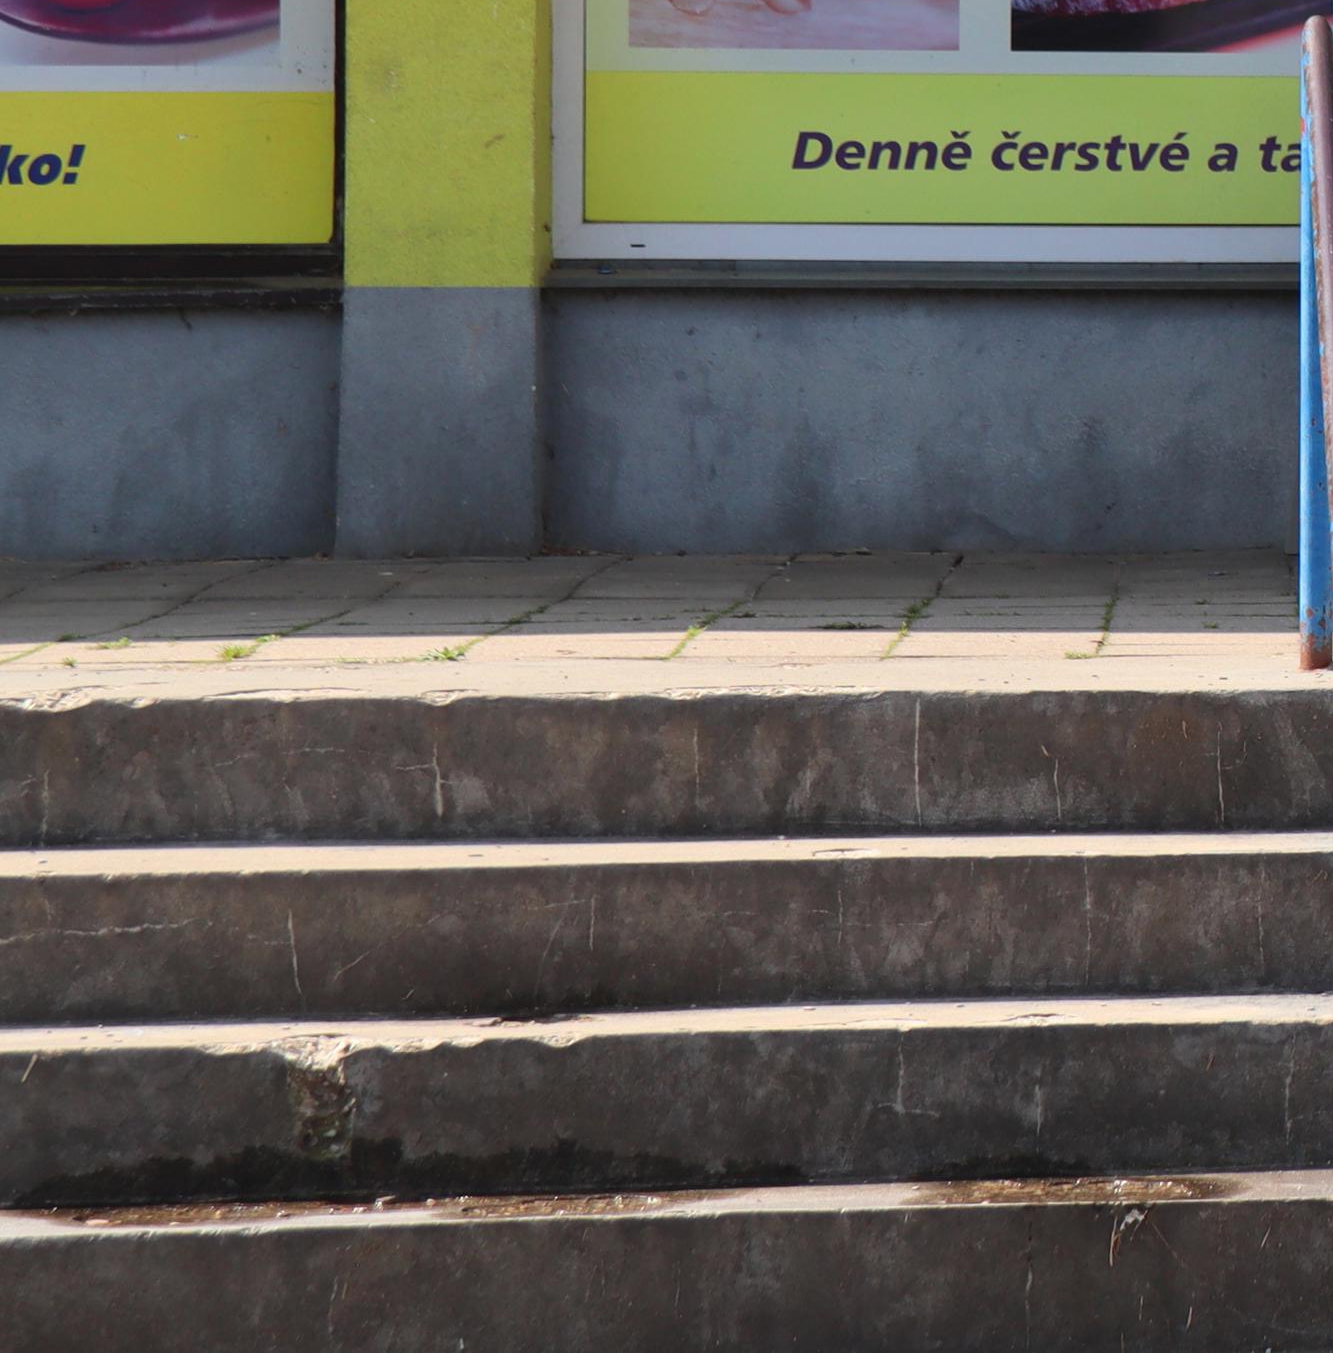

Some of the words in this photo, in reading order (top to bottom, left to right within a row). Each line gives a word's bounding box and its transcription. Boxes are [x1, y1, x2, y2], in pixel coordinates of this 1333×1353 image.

[791, 131, 973, 170] Denně
[991, 131, 1190, 173] čerstvé
[1207, 140, 1239, 173] a
